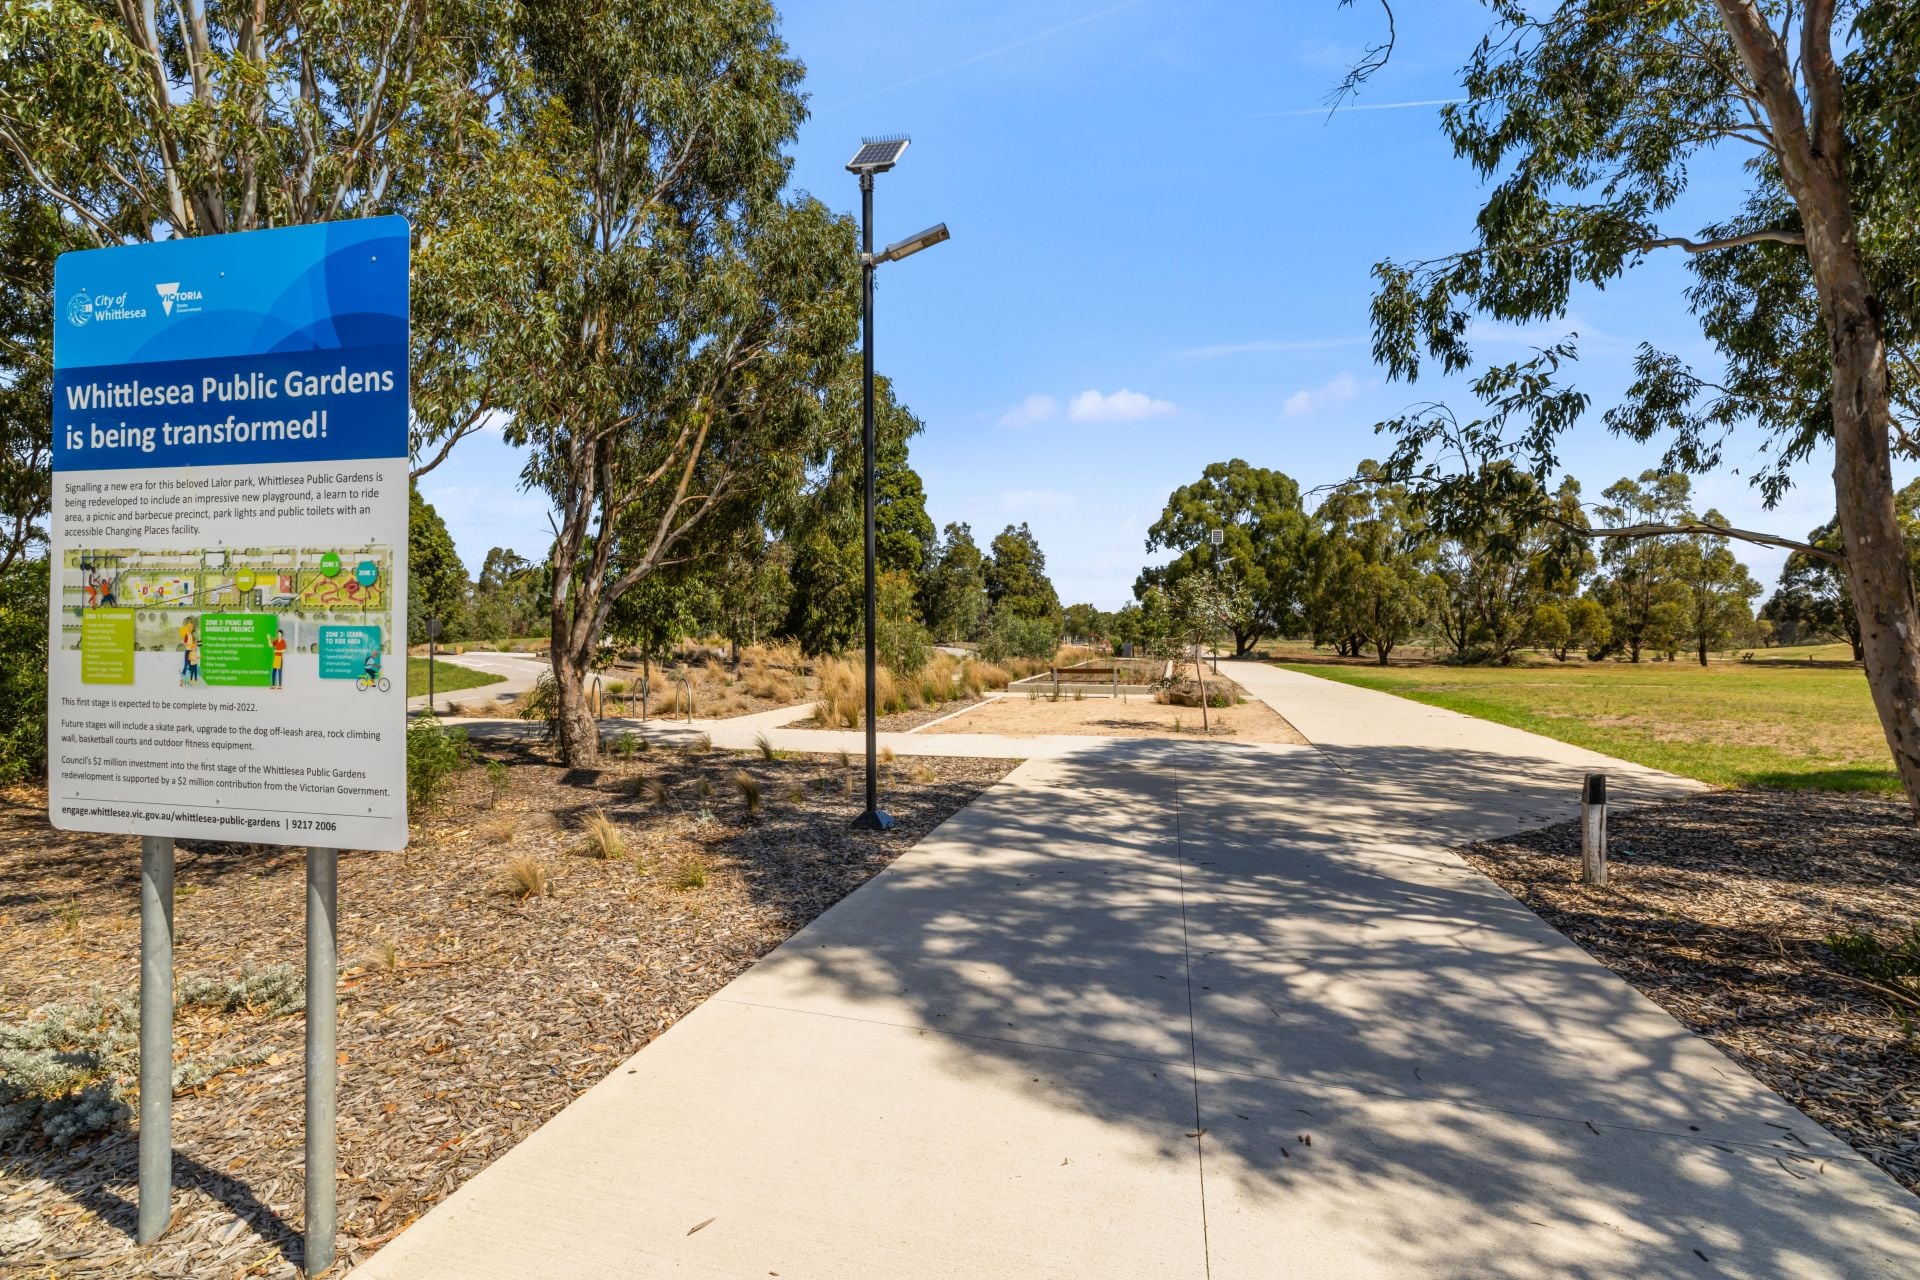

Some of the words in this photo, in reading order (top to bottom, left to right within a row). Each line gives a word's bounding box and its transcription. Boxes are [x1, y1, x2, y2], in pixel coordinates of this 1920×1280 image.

[95, 295, 114, 309] City
[116, 292, 128, 308] of
[161, 291, 203, 302] VICTORIA
[95, 308, 147, 322] Whittlesea
[66, 381, 194, 410] Whittlesea
[202, 373, 278, 402] Public
[284, 366, 394, 397] Gardens
[66, 424, 84, 450] is
[91, 422, 156, 453] being
[162, 410, 327, 446] transformed!
[65, 482, 102, 494] Signalling
[111, 483, 128, 491] new
[130, 482, 143, 491] era
[145, 480, 157, 490] for
[159, 480, 174, 490] this
[176, 478, 209, 489] beloved
[211, 478, 232, 488] Lalor
[234, 477, 255, 489] park,
[258, 475, 304, 486] Whittlesea
[307, 474, 333, 484] Public
[336, 473, 374, 484] Gardens
[376, 472, 383, 482] is
[64, 497, 87, 509] being
[88, 496, 138, 508] redeveloped
[140, 497, 149, 505] to
[150, 494, 181, 505] include
[182, 496, 193, 504] an
[195, 493, 240, 505] impressive
[242, 494, 260, 502] new
[262, 490, 314, 504] playground,
[316, 492, 322, 500] a
[323, 489, 347, 500] learn
[349, 489, 359, 499] to
[361, 488, 380, 498] ride
[64, 514, 84, 523] area,
[86, 514, 91, 522] a
[92, 511, 116, 523] picnic
[117, 510, 133, 521] and
[134, 510, 173, 520] barbecue
[175, 509, 211, 521] precinct,
[213, 508, 232, 520] park
[234, 508, 257, 520] lights
[259, 507, 276, 517] and
[278, 506, 304, 519] public
[306, 506, 334, 516] toilets
[336, 505, 357, 515] with
[359, 506, 371, 515] an
[64, 526, 104, 537] accessible
[105, 526, 142, 538] Changing
[144, 525, 170, 535] Places
[171, 524, 200, 536] facility.
[61, 697, 75, 706] This
[77, 698, 90, 707] first
[91, 699, 110, 709] stage
[111, 699, 117, 708] is
[118, 700, 151, 709] expected
[152, 701, 160, 709] to
[161, 700, 171, 709] be
[172, 701, 207, 711] complete
[208, 701, 218, 712] by
[219, 702, 258, 712] mid-2022.
[61, 719, 84, 728] Future
[85, 721, 107, 731] stages
[108, 721, 121, 729] will
[122, 721, 148, 731] include
[156, 722, 174, 732] skate
[176, 723, 194, 734] park,
[196, 725, 227, 735] upgrade
[228, 726, 237, 734] to
[238, 725, 252, 735] the
[253, 726, 268, 738] dog
[269, 726, 303, 737] off-leash
[305, 730, 325, 739] area,
[327, 729, 344, 738] rock
[346, 729, 381, 742] climbing
[61, 734, 78, 744] wall,
[78, 735, 114, 744] basketball
[114, 737, 138, 745] courts
[138, 737, 152, 746] and
[153, 738, 184, 747] outdoor
[185, 738, 210, 749] fitness
[211, 740, 254, 751] equipment.
[61, 756, 92, 765] Council's
[93, 757, 102, 766] $2
[103, 758, 128, 767] million
[129, 758, 168, 769] investment
[170, 760, 185, 770] into
[186, 761, 199, 771] the
[200, 762, 215, 772] first
[217, 764, 237, 774] stage
[238, 763, 247, 773] of
[248, 764, 261, 774] the
[262, 765, 305, 776] Whittlesea
[306, 767, 330, 777] Public
[332, 768, 366, 779] Gardens
[61, 771, 114, 782] redevelopment
[115, 773, 121, 782] is
[122, 775, 159, 784] supported
[161, 775, 170, 786] by
[178, 776, 187, 786] $2
[189, 777, 214, 787] million
[216, 779, 262, 789] contribution
[264, 780, 283, 791] from
[284, 782, 298, 792] the
[299, 783, 335, 794] Victorian
[337, 785, 390, 797] Government.
[61, 806, 281, 828] engage.whittlesea.vic.gov.au/whittlesea-public-gardens
[292, 819, 313, 830] 9217
[315, 821, 337, 831] 2006
